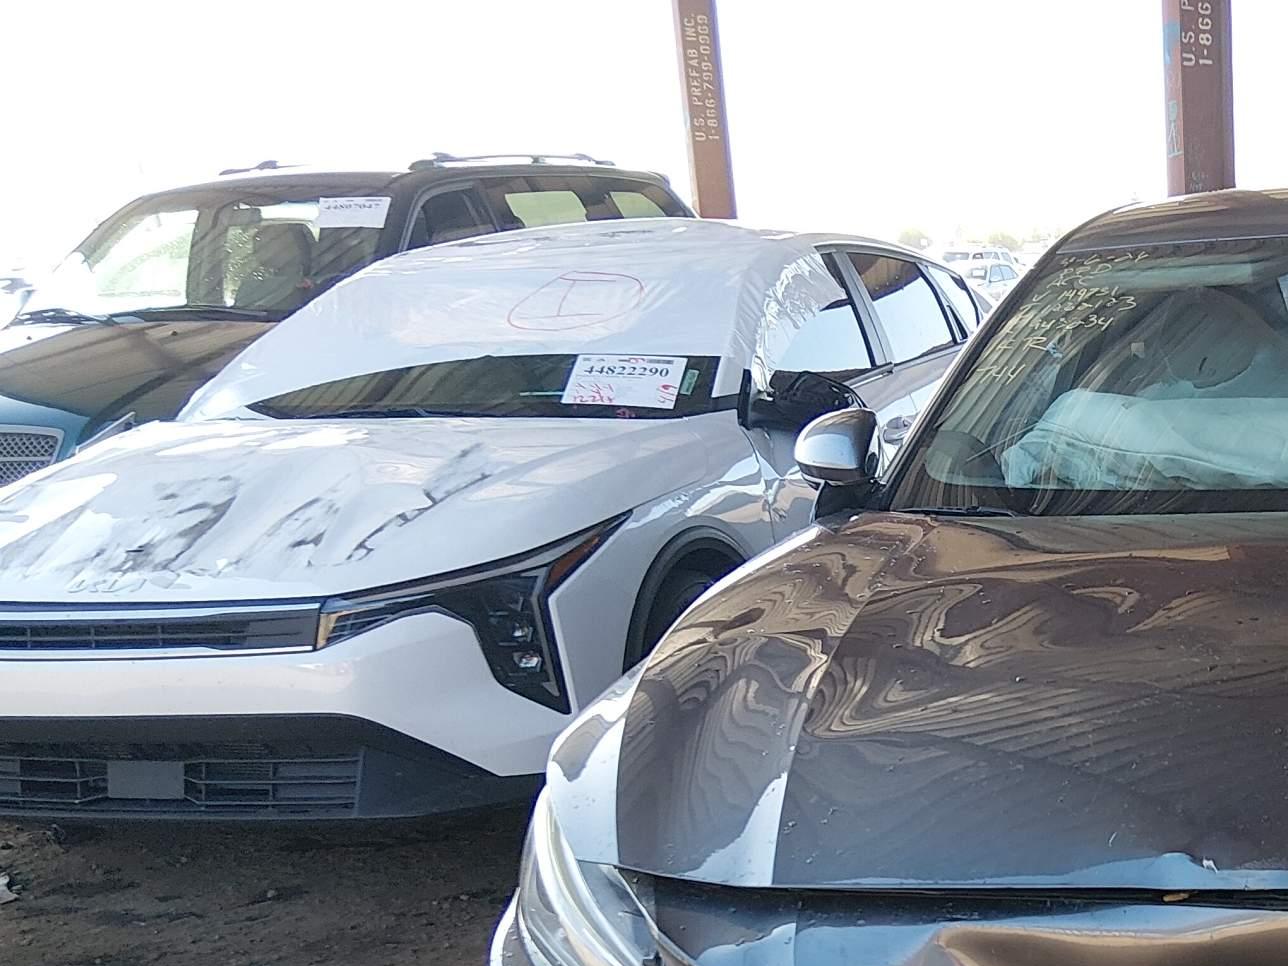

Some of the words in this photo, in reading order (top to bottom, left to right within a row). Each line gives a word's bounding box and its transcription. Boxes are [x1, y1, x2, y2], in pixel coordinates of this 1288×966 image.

[684, 13, 697, 41] INC.
[1182, 25, 1196, 66] U.S.
[687, 49, 704, 105] PREFAB
[583, 365, 670, 378] 44822290
